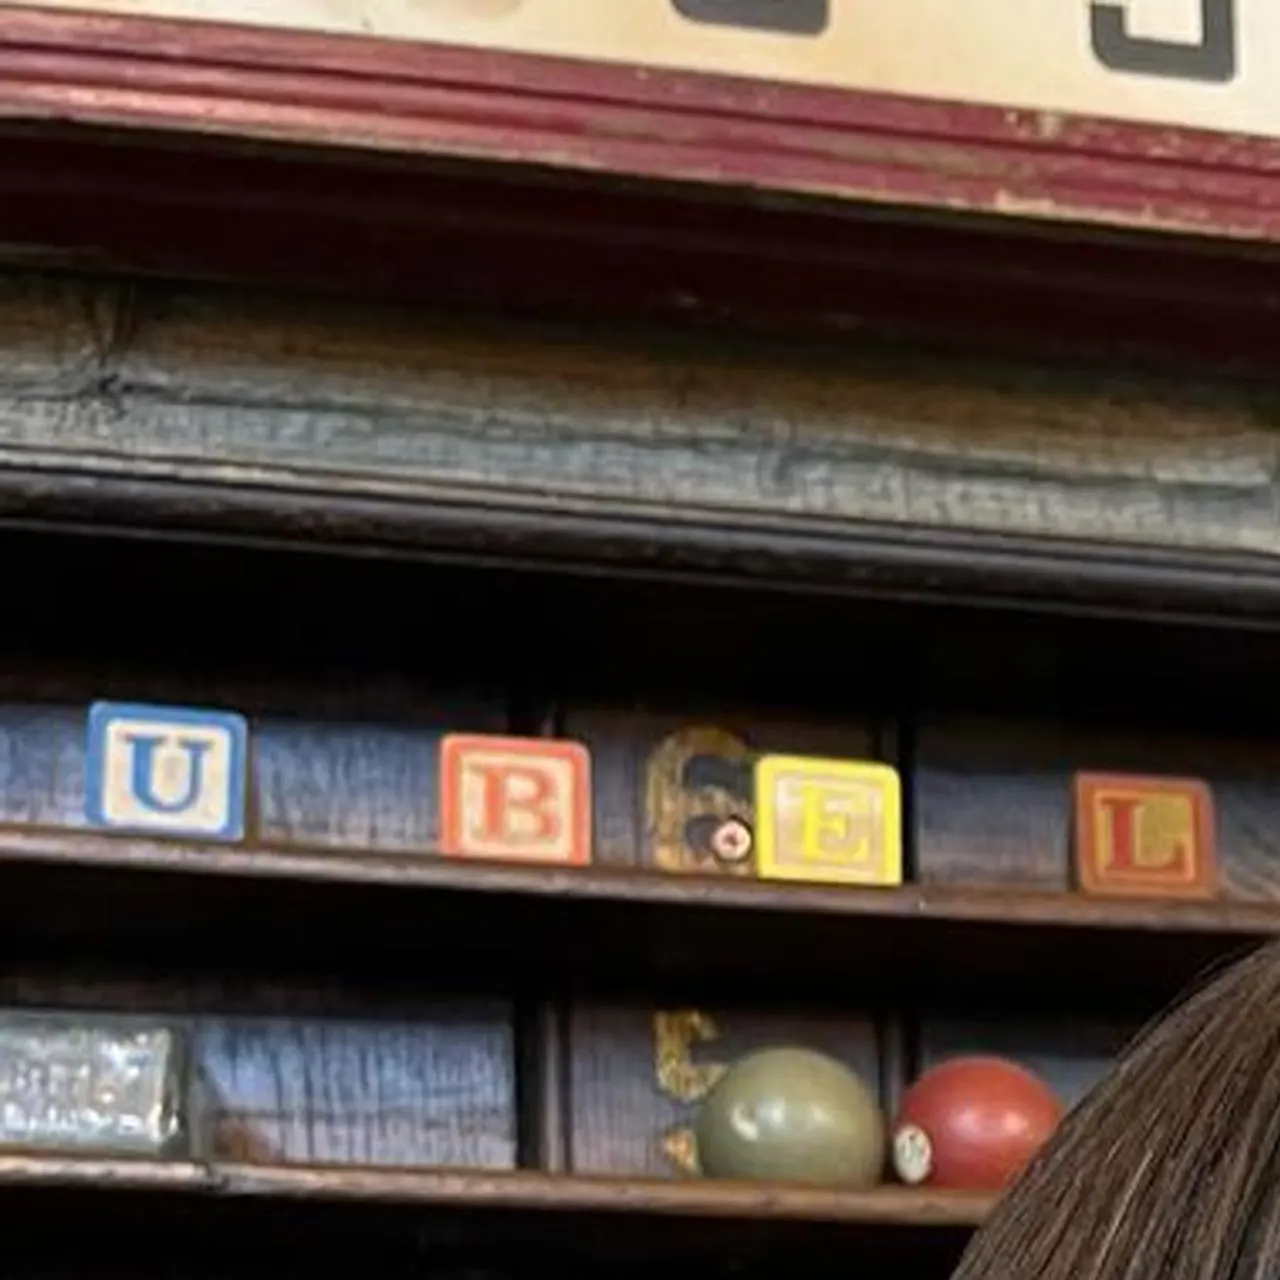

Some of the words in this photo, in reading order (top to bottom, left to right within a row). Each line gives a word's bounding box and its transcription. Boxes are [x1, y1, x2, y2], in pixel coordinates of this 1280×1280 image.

[121, 733, 215, 815] U
[469, 766, 560, 845] B
[803, 786, 868, 862] E
[1101, 797, 1189, 874] L
